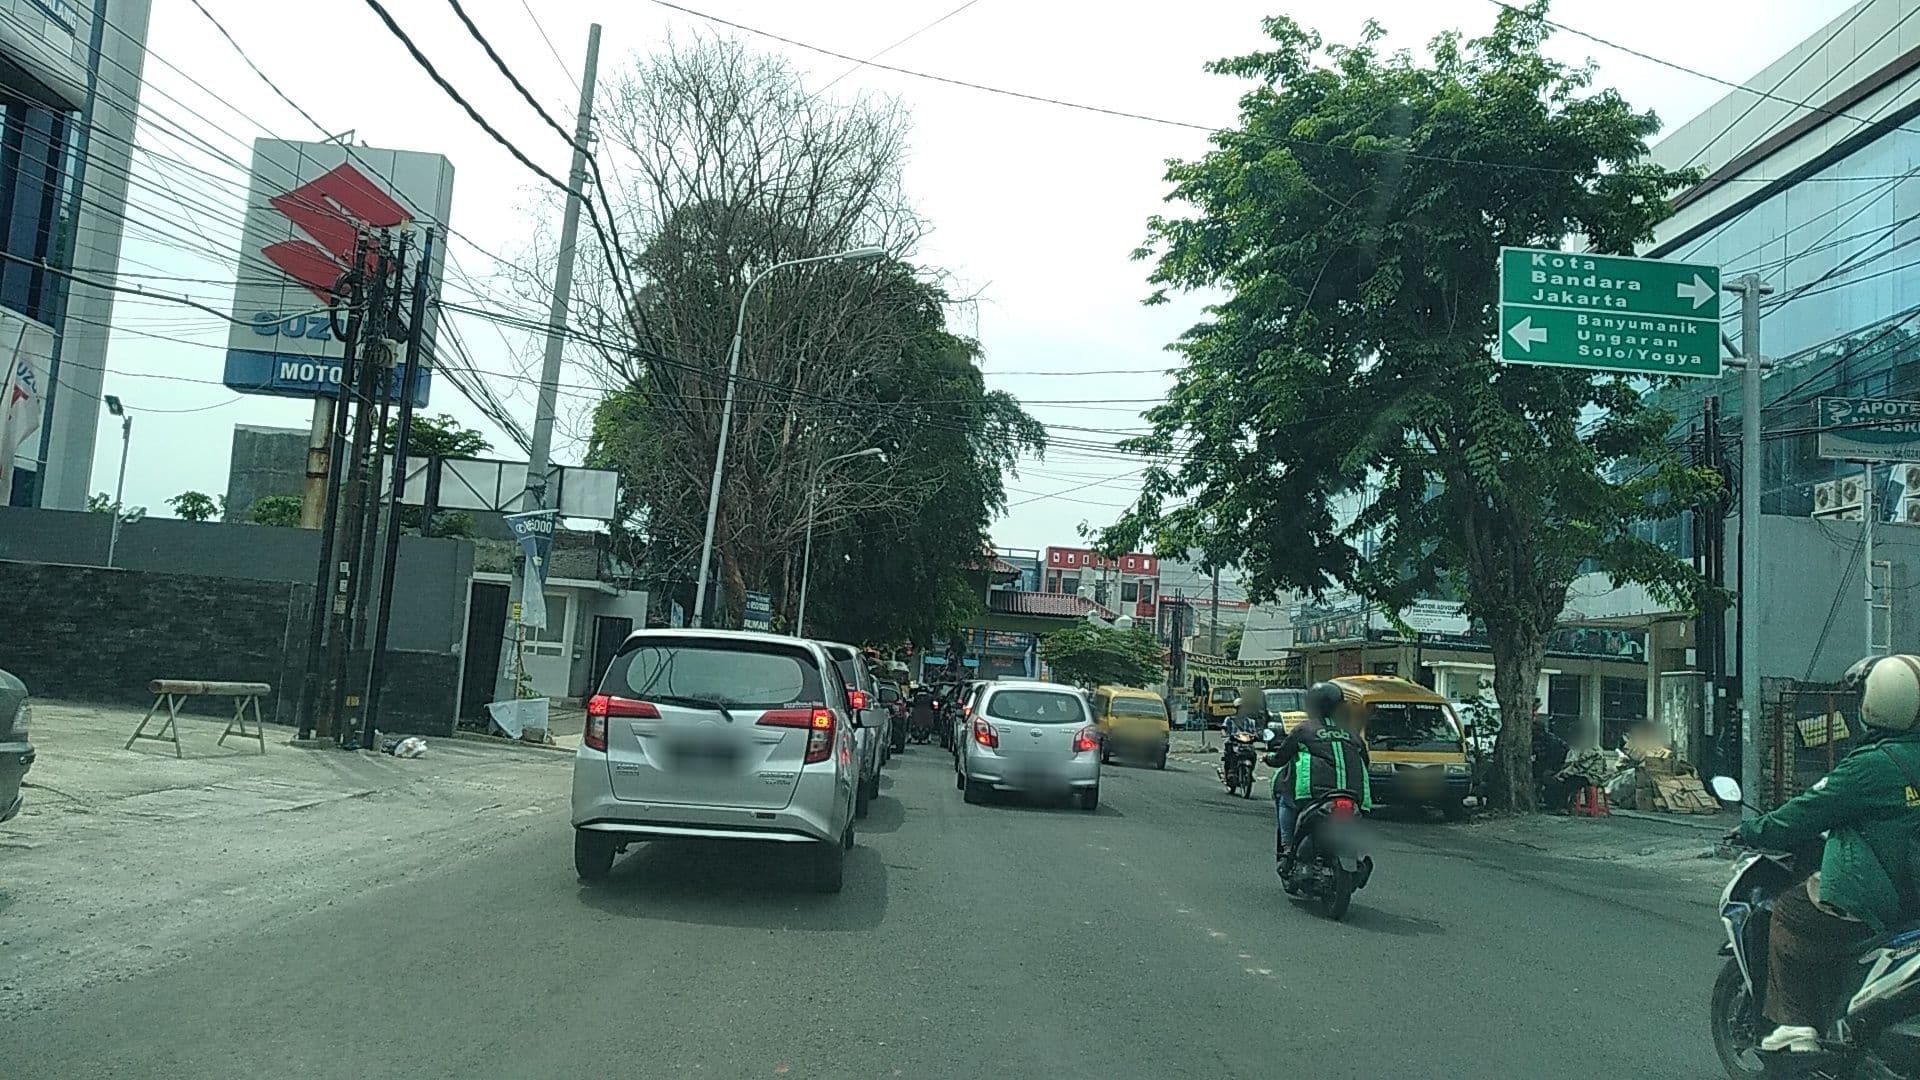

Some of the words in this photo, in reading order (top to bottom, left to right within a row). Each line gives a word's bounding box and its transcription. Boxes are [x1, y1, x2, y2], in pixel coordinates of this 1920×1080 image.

[1531, 253, 1595, 270] Kota
[1531, 270, 1641, 291] Bandara
[1532, 288, 1627, 308] Jakarta
[1577, 314, 1697, 334] Banyumanik
[1577, 330, 1679, 348] Ungaran
[1578, 344, 1702, 365] Solo/Yogya
[1317, 728, 1350, 740] Grab
